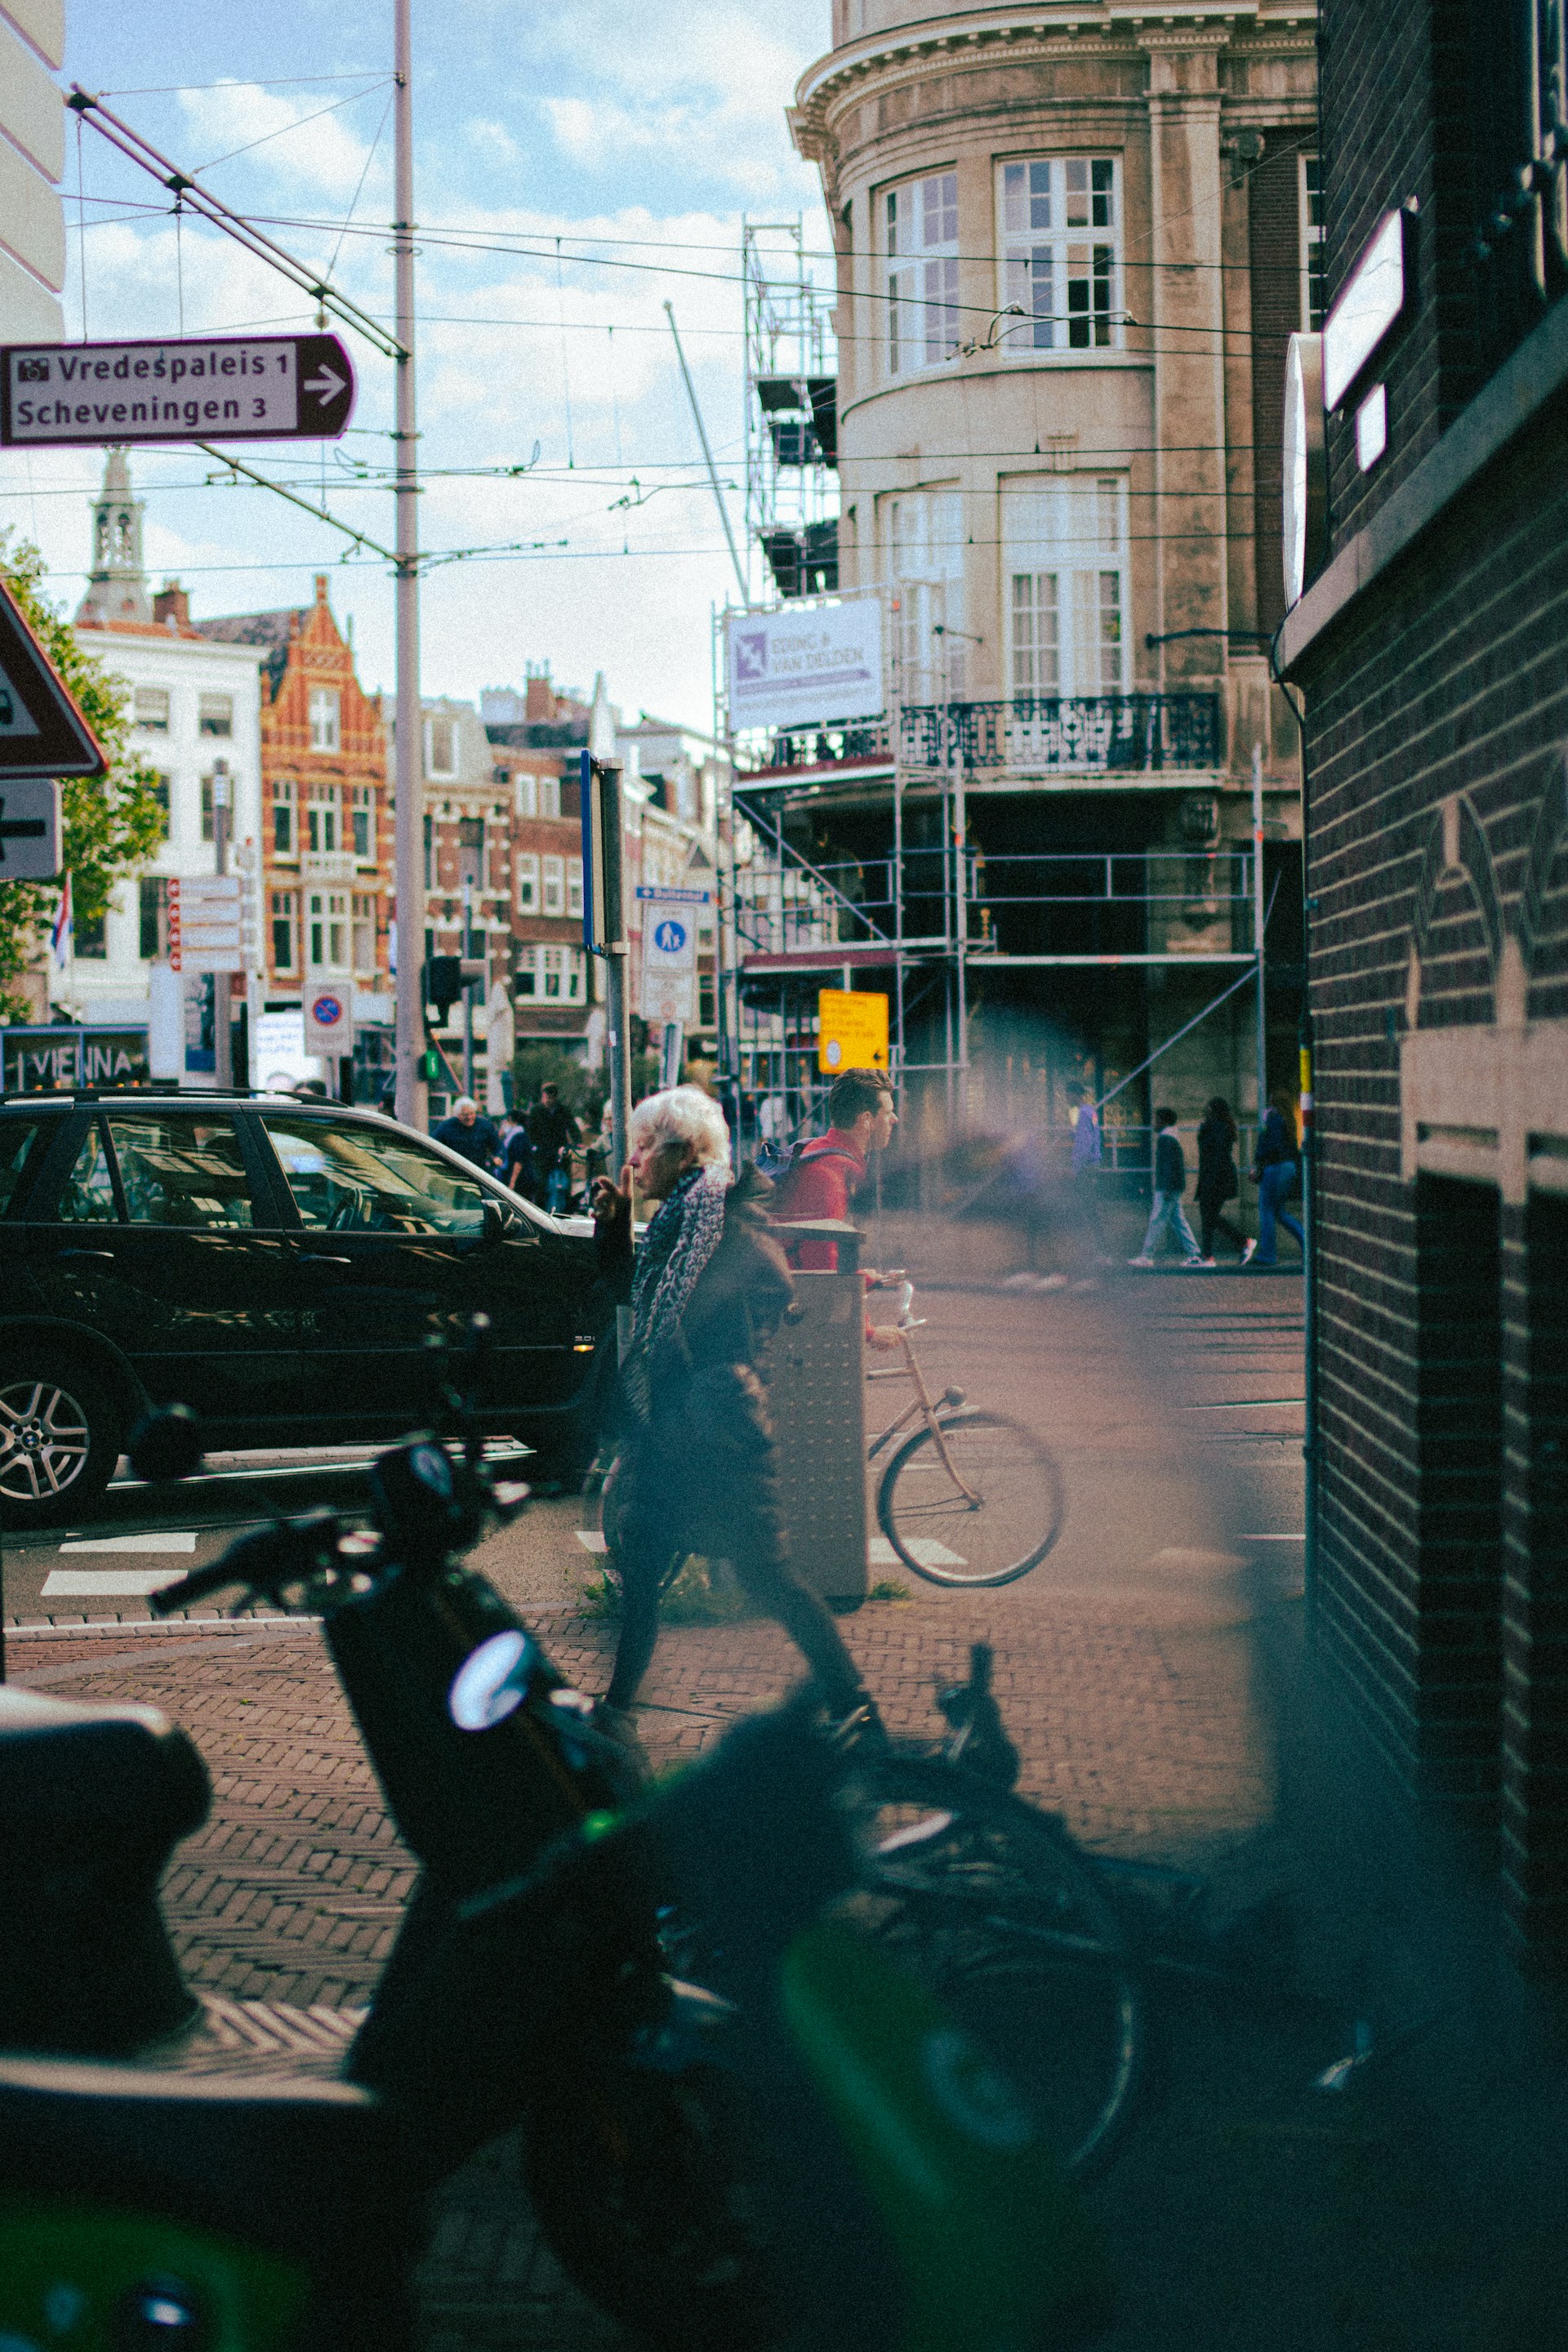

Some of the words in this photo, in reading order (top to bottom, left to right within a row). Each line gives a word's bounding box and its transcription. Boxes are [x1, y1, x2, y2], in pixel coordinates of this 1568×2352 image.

[58, 351, 265, 383] Vredespaleis
[276, 354, 288, 374] 1
[17, 396, 240, 425] Scheveningen
[252, 398, 266, 417] 3
[32, 1046, 131, 1080] VIENNA
